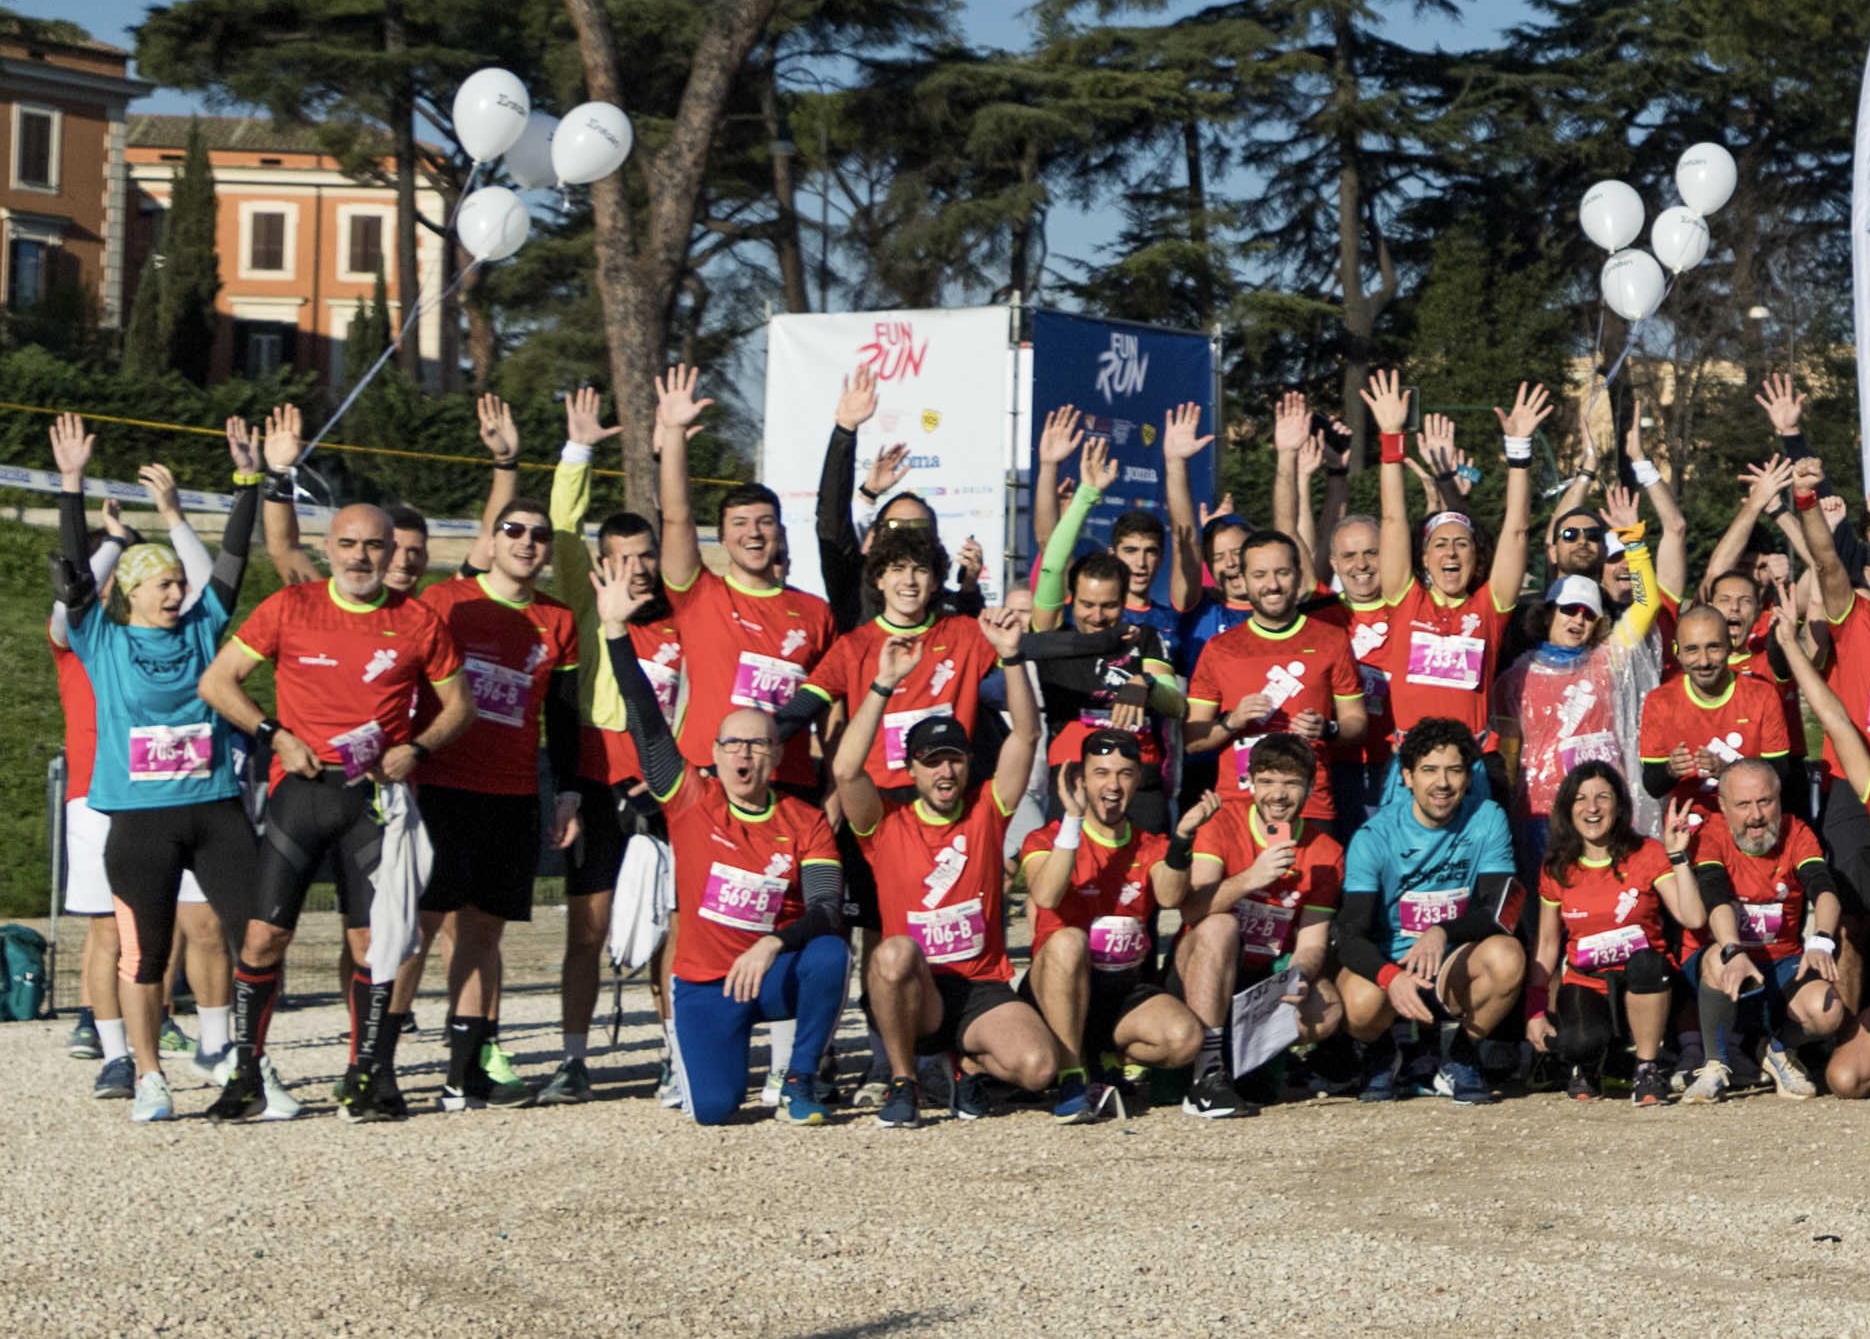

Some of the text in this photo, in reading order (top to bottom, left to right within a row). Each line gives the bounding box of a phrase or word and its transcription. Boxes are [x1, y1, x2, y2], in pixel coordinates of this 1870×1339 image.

[875, 322, 912, 347] FUN
[1111, 333, 1138, 359] FUN
[857, 337, 929, 382] RUN
[1096, 352, 1148, 404] RUN
[1424, 650, 1468, 671] 733-A
[473, 678, 518, 705] 596-B
[751, 670, 796, 698] 707-A
[719, 883, 769, 912] 569-B
[1412, 904, 1457, 924] 733-B
[922, 920, 971, 946] 706-B
[1105, 933, 1143, 953] 737-C
